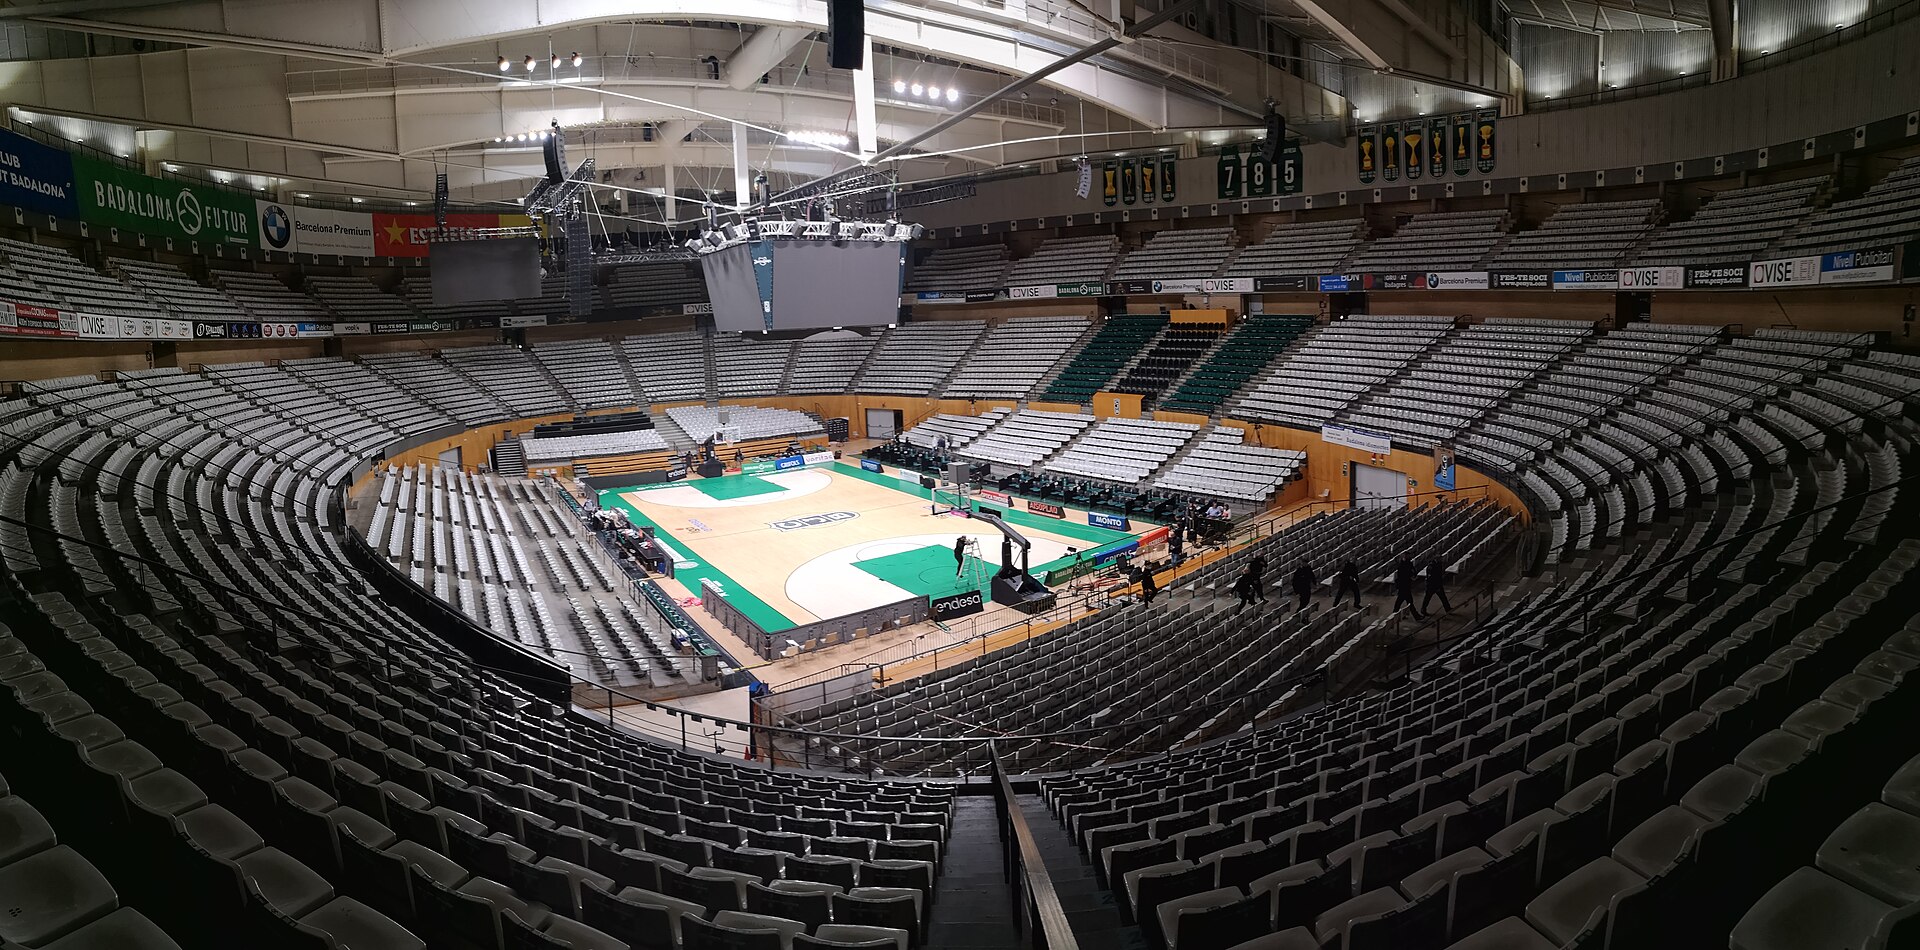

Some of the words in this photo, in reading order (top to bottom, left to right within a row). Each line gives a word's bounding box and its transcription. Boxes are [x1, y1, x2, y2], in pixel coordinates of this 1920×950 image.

[1224, 166, 1234, 189] 7
[1253, 162, 1264, 186] 8
[1284, 159, 1295, 184] 5
[10, 172, 66, 199] BADALONA
[94, 180, 175, 222] BADALONA
[205, 206, 248, 234] FUTUR
[295, 221, 333, 234] Barcelona
[334, 224, 371, 236] Premium
[1833, 254, 1853, 269] Nivell
[1464, 277, 1487, 285] Premium
[1500, 274, 1528, 282] FES-TE
[1564, 272, 1584, 282] Nivell
[1694, 270, 1723, 279] FES-TE
[1724, 268, 1744, 277] SOCI
[205, 324, 225, 336] SPALDING
[667, 468, 686, 478] endesa
[1095, 516, 1122, 527] MONTO
[936, 594, 981, 613] endesa
